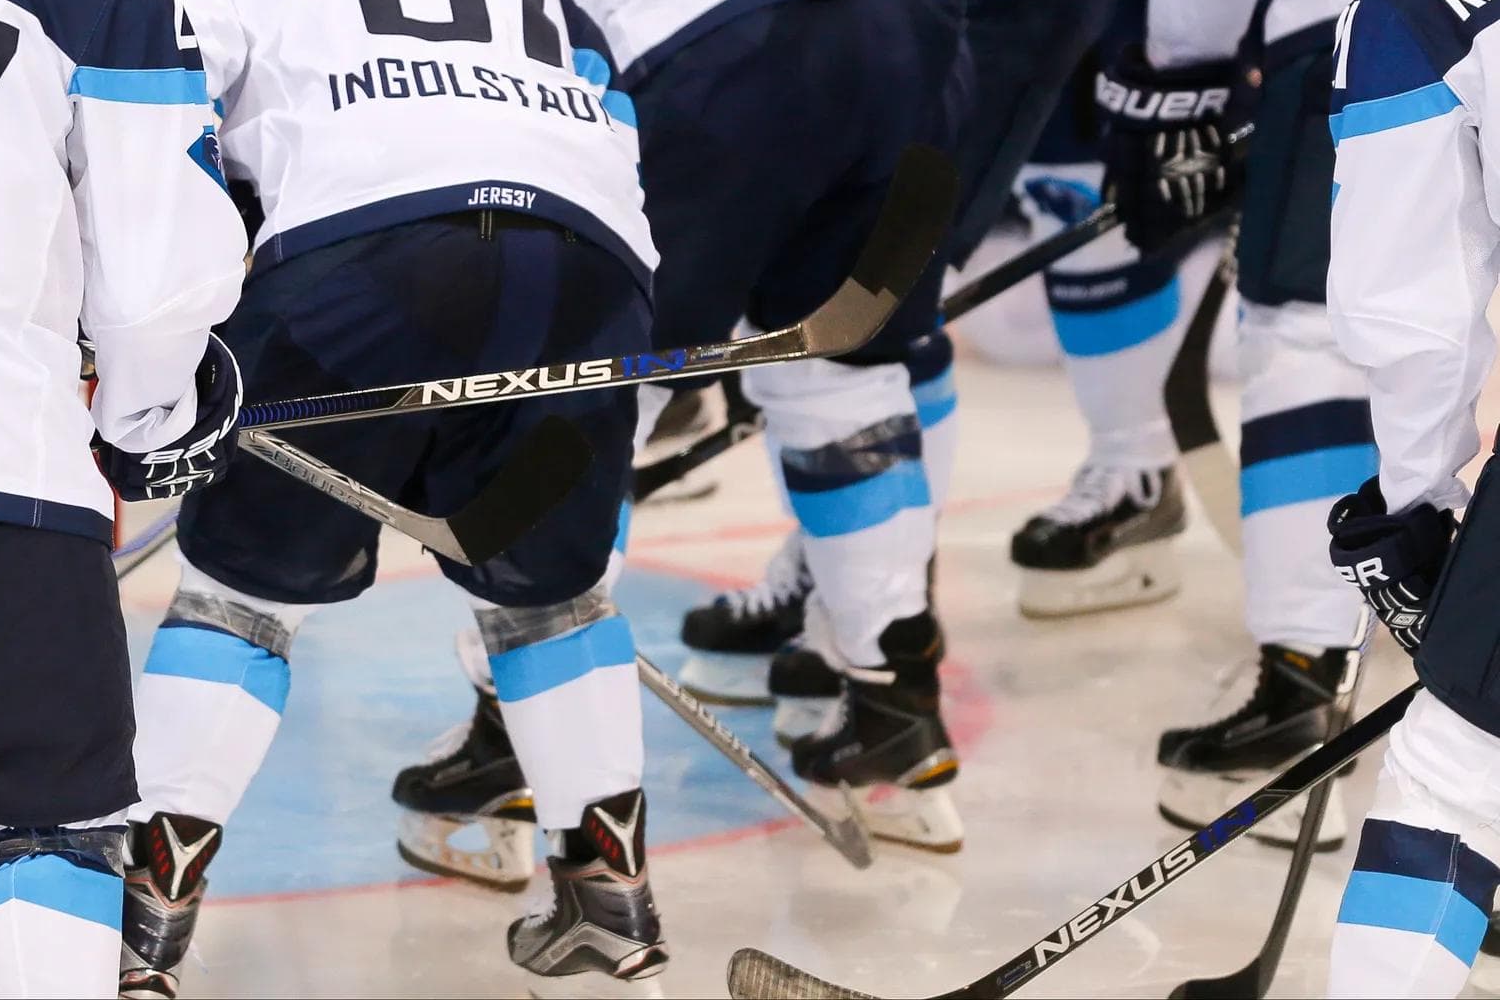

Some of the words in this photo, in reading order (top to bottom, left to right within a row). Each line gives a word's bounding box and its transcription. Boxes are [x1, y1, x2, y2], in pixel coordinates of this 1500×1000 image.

[328, 56, 617, 134] INGOLSTADT
[421, 358, 613, 405] NEXUS
[1033, 839, 1197, 968] NEXUS
